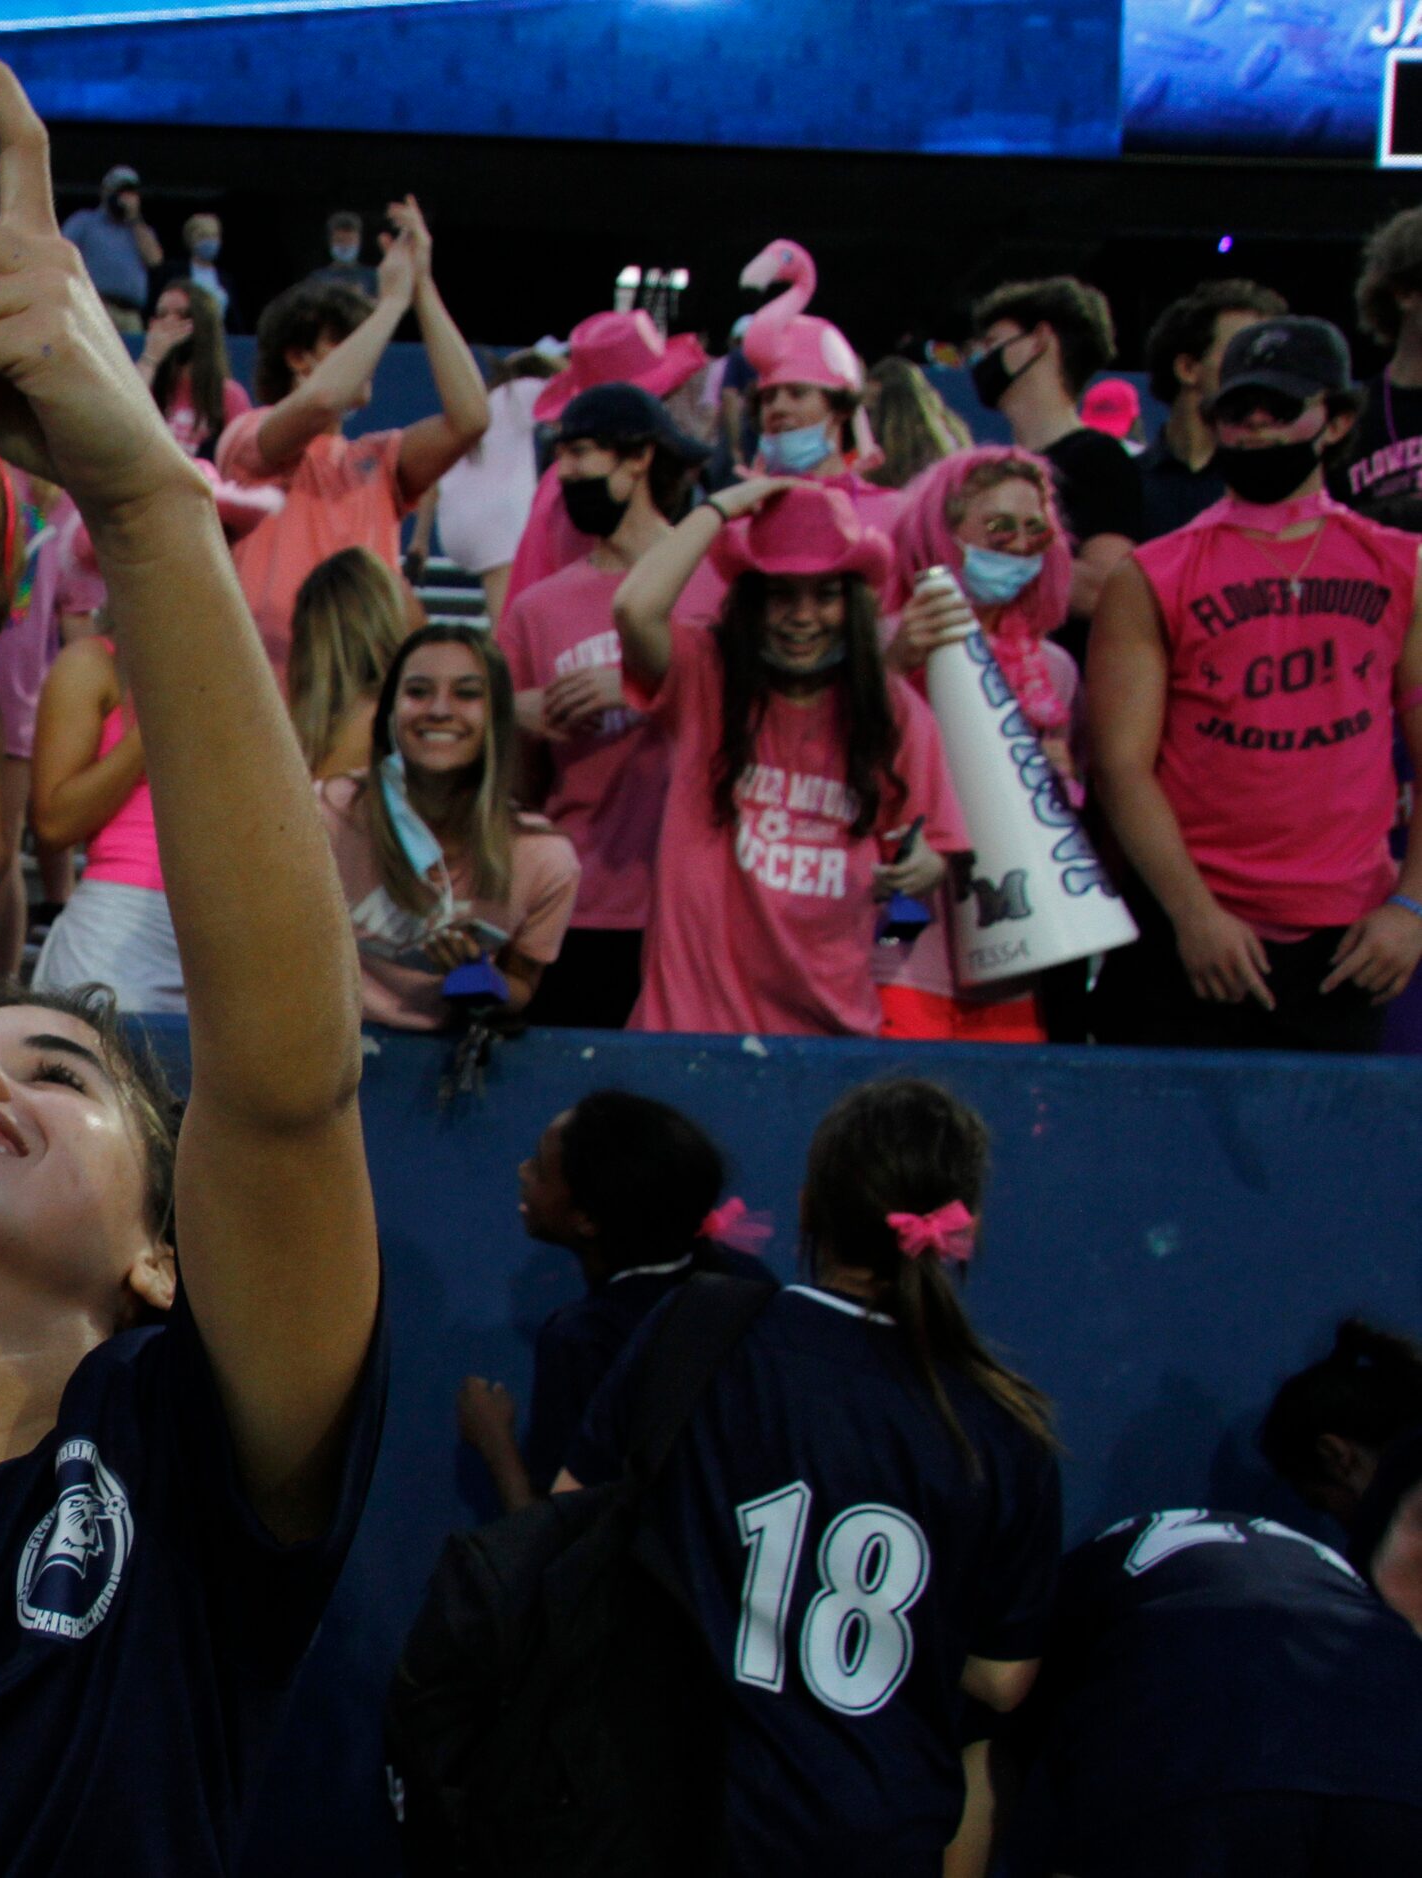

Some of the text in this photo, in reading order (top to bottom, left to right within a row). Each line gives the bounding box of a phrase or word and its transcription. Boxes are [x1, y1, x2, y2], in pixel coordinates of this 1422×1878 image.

[1244, 638, 1335, 699] GO!
[1194, 708, 1374, 751] JAGUARS
[734, 1480, 931, 1717] 18
